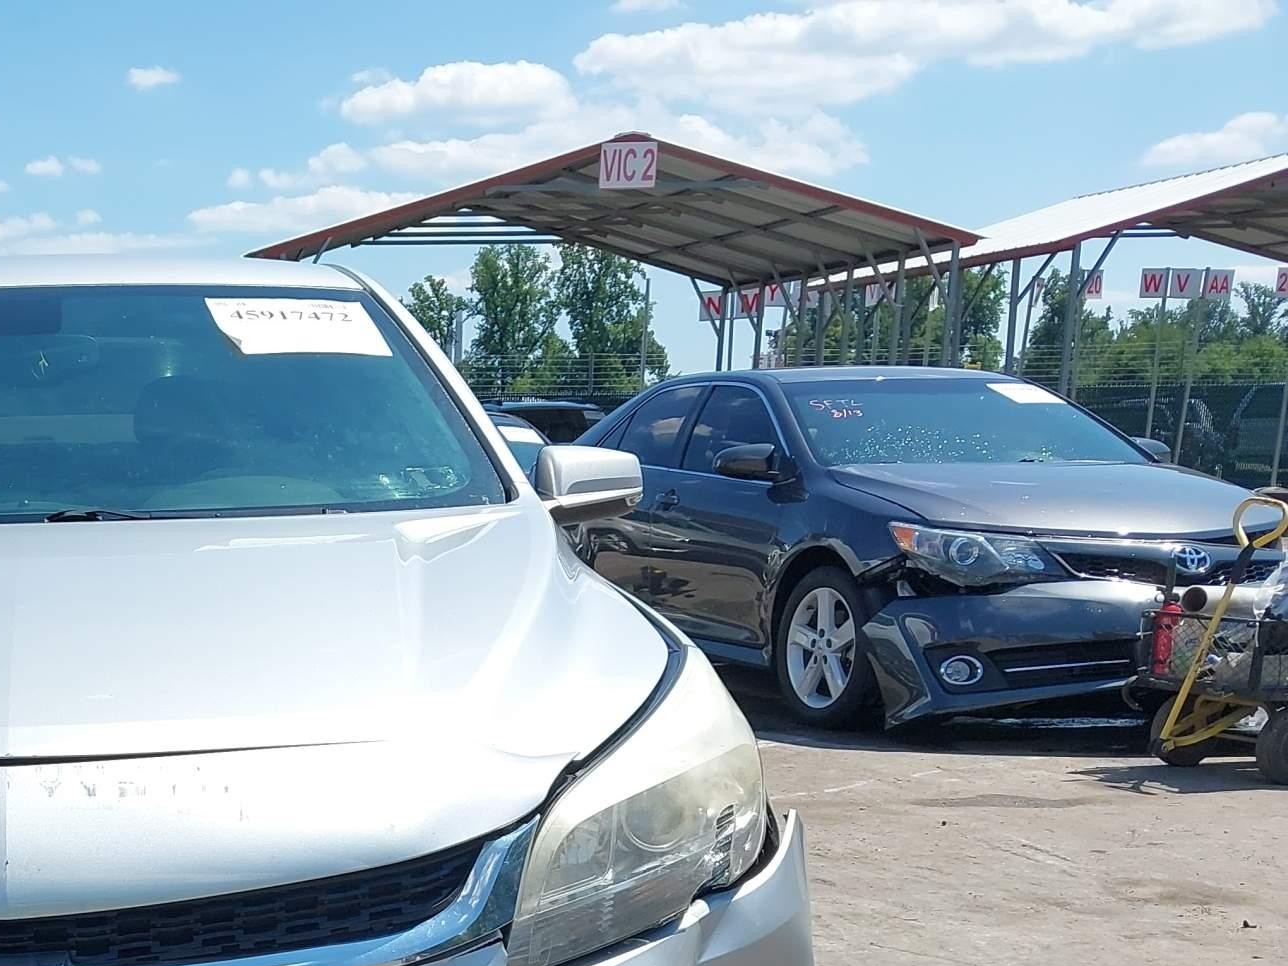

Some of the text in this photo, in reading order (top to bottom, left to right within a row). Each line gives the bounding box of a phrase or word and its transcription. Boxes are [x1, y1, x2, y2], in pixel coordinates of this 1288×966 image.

[603, 148, 655, 181] VIC 2
[1143, 273, 1163, 293] W
[1176, 273, 1190, 293] V
[1208, 275, 1229, 294] AA
[230, 310, 352, 322] 45917472
